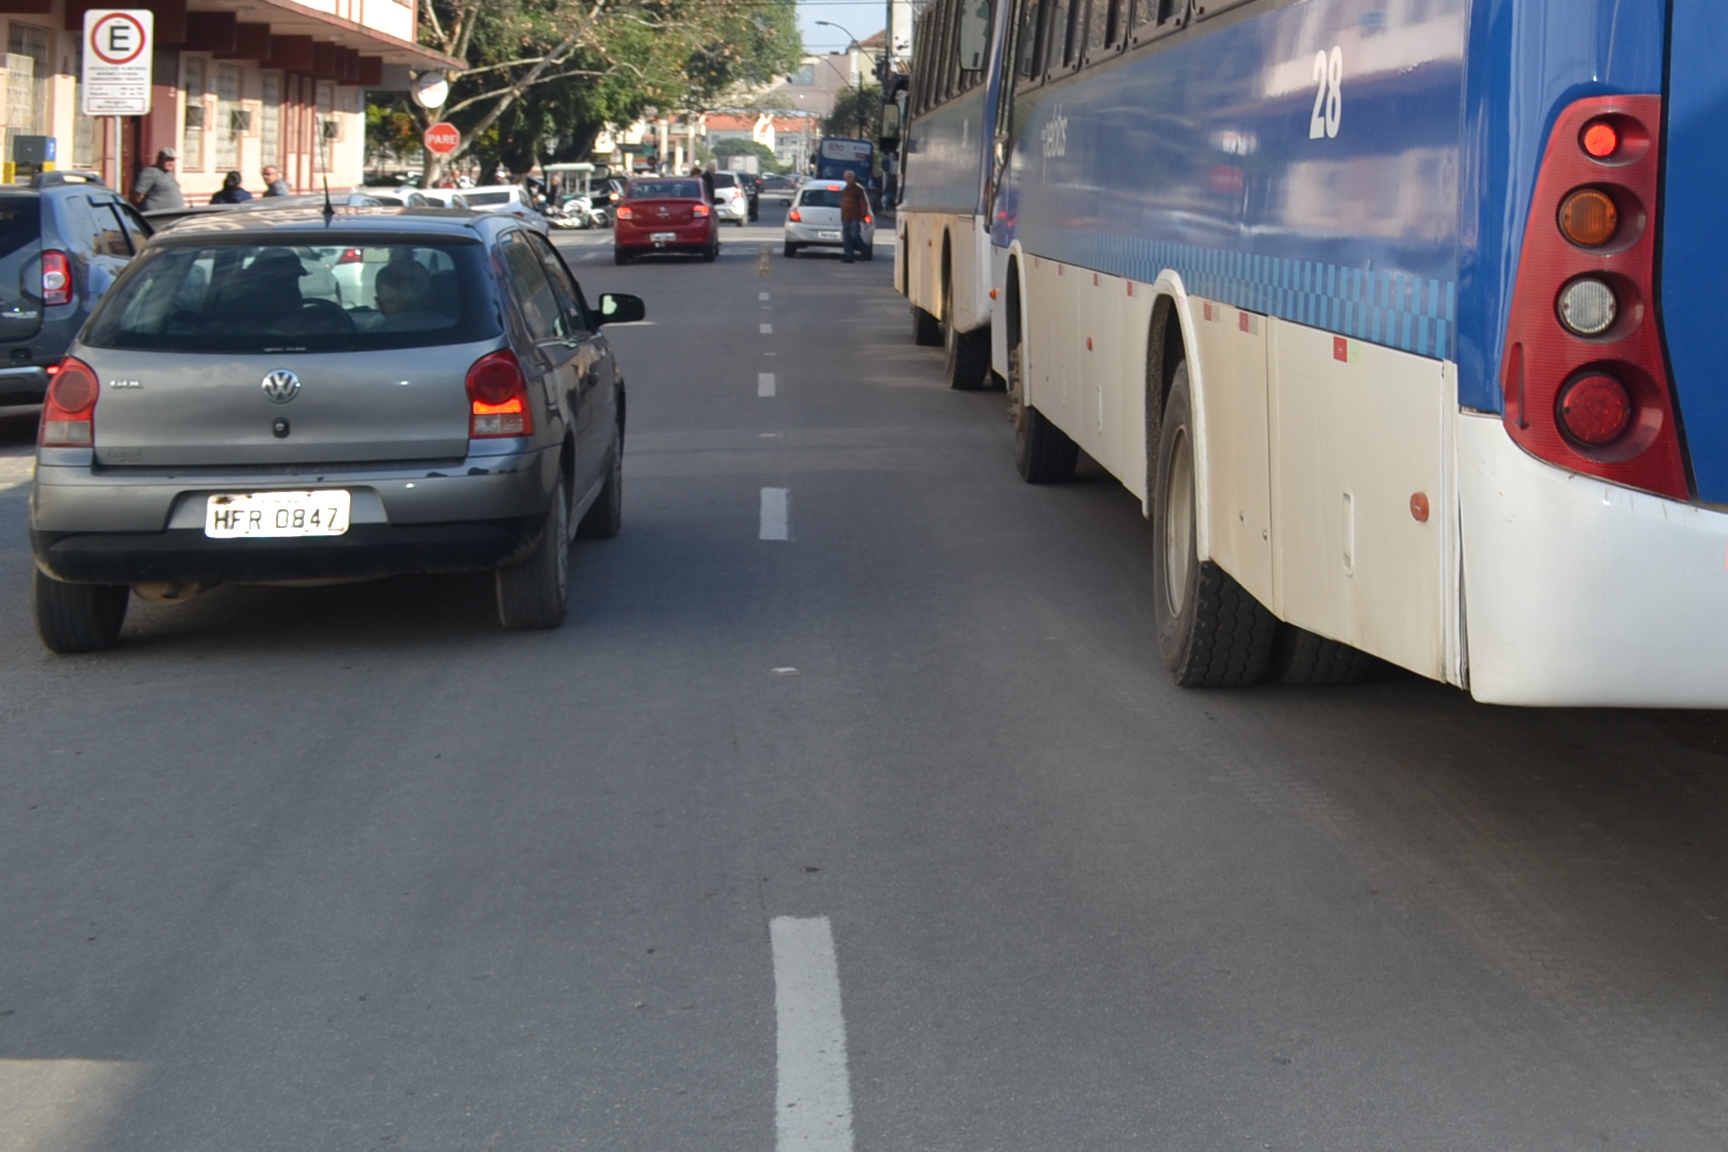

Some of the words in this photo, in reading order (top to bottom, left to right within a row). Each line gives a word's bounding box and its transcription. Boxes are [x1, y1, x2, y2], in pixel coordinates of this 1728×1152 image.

[109, 25, 131, 51] E
[1309, 45, 1343, 140] 28
[428, 133, 457, 145] PARE
